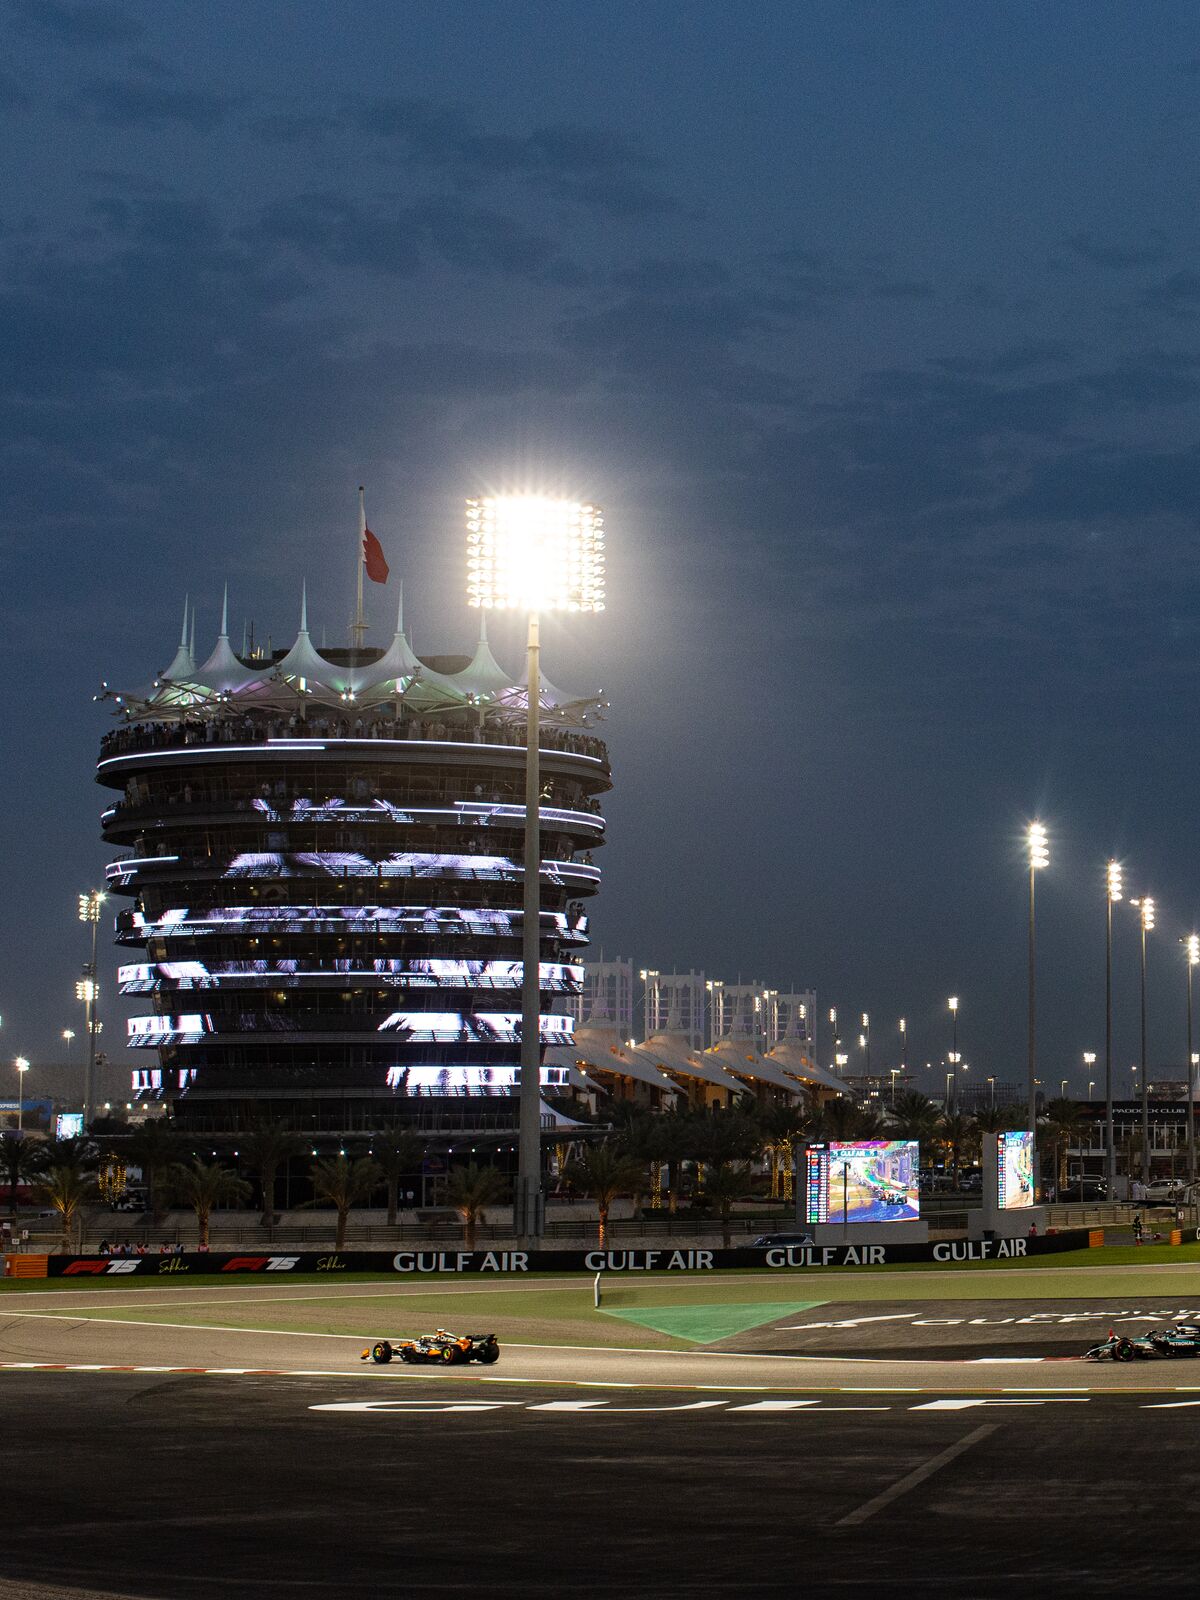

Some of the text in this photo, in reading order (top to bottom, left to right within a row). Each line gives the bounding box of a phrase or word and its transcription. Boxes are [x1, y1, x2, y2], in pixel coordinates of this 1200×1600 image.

[766, 1245, 886, 1268] GULF AIR
[933, 1238, 1027, 1262] GULF AIR
[159, 1257, 190, 1275] Sakhir
[316, 1255, 346, 1271] Sakhir
[393, 1251, 529, 1272] GULF AIR
[585, 1250, 714, 1271] GULF AIR
[911, 1316, 1103, 1326] GULF
[307, 1398, 1092, 1412] GULF
